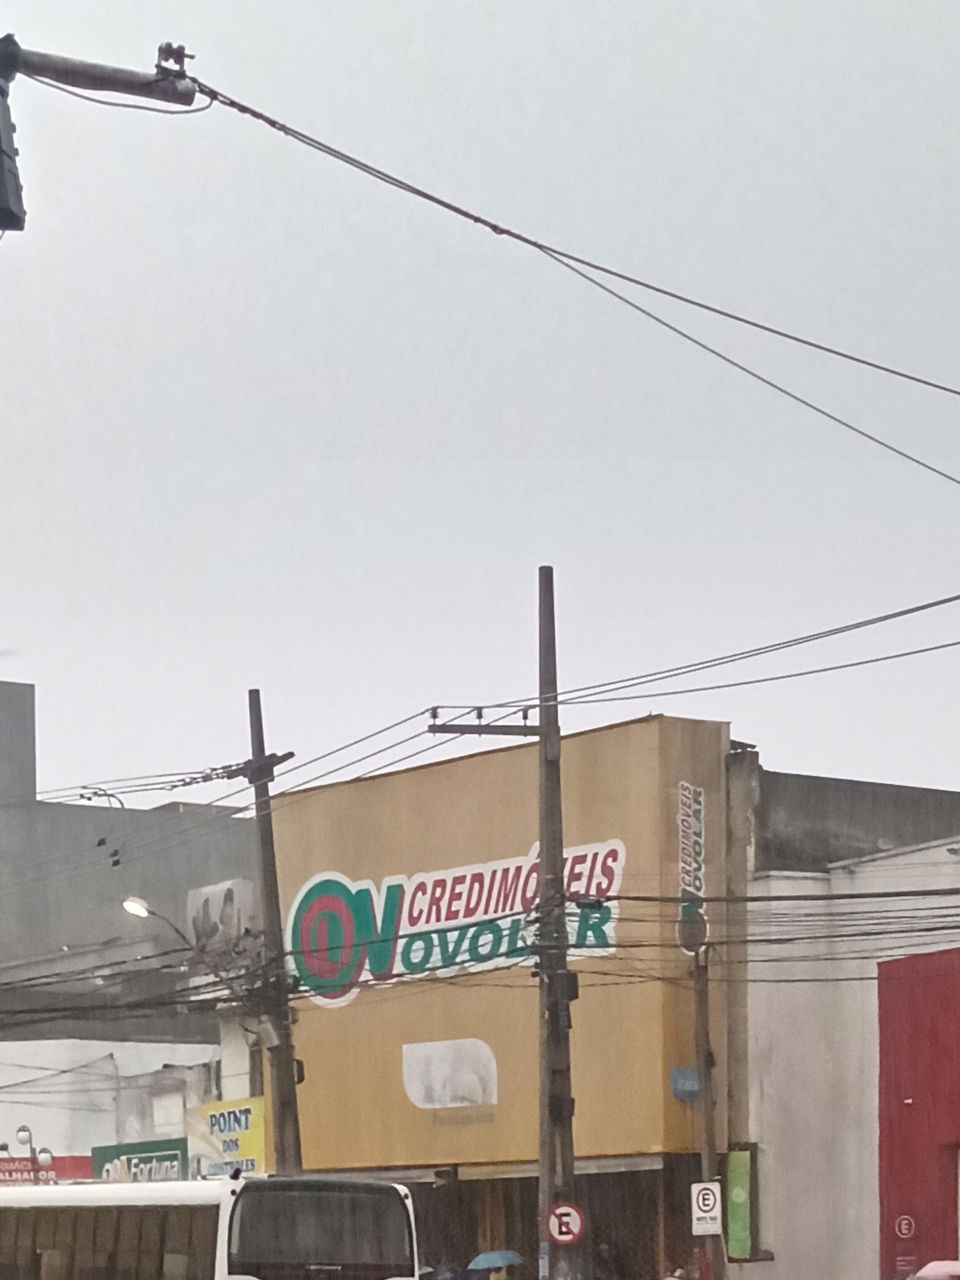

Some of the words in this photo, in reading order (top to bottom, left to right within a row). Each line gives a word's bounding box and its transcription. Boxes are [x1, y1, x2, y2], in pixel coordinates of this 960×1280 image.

[406, 848, 618, 928] CREDIMÓEIS
[209, 1107, 252, 1136] POINT
[222, 1138, 240, 1153] DOS
[130, 1158, 179, 1181] Fortuna
